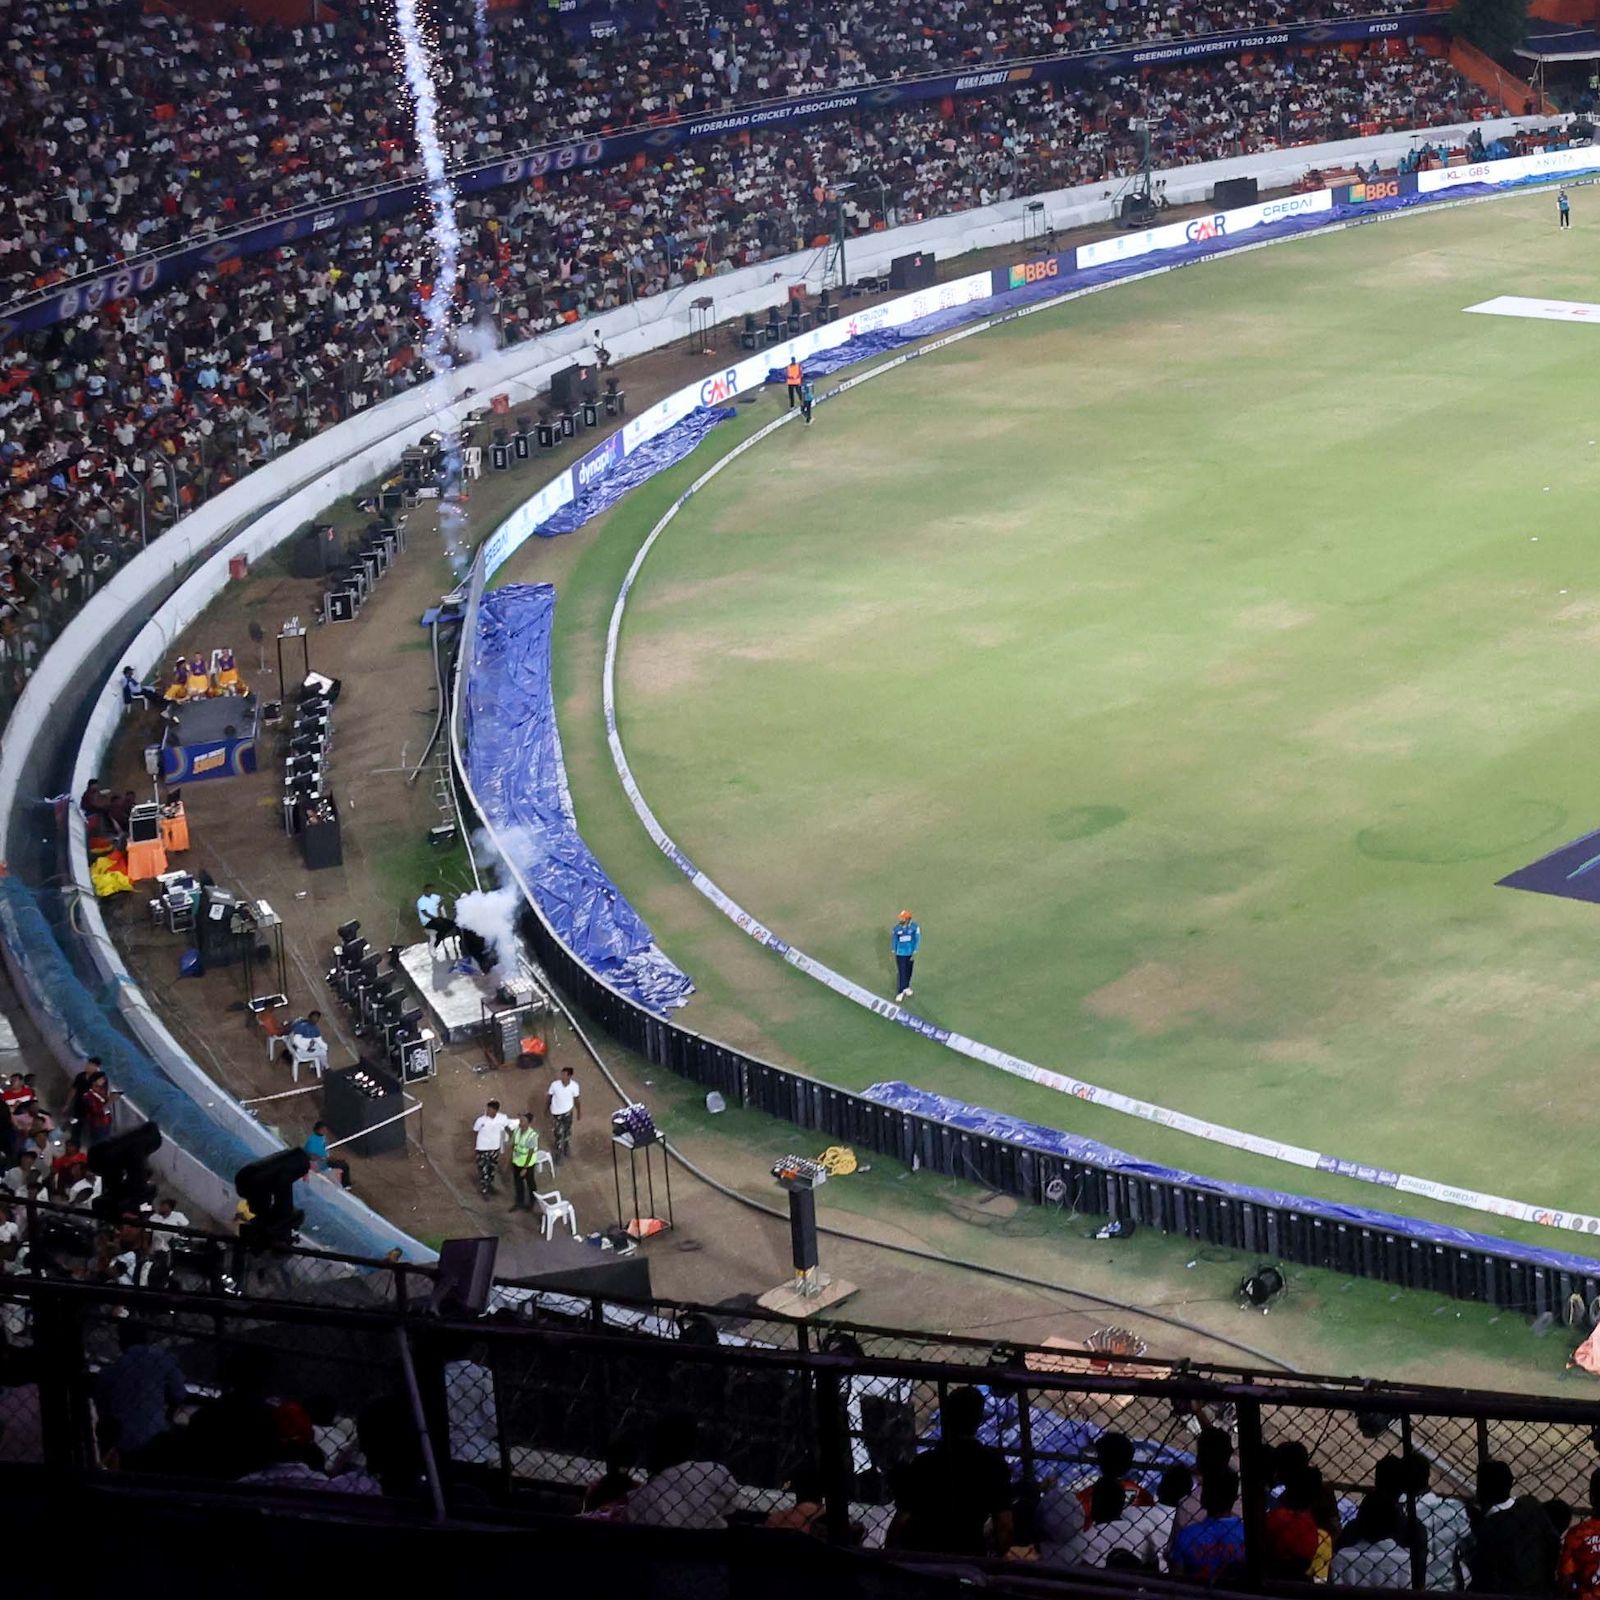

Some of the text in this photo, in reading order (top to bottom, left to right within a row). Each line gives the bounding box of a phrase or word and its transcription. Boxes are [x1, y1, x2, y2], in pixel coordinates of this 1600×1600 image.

[1368, 21, 1399, 33] #TG20
[1132, 33, 1289, 63] SREENIDHI UNIVERSITY TG20 2026
[689, 98, 858, 135] HYDERABAD CRICKET ASSOCIATION
[1366, 182, 1398, 201] BBG
[1025, 258, 1058, 281] BBG
